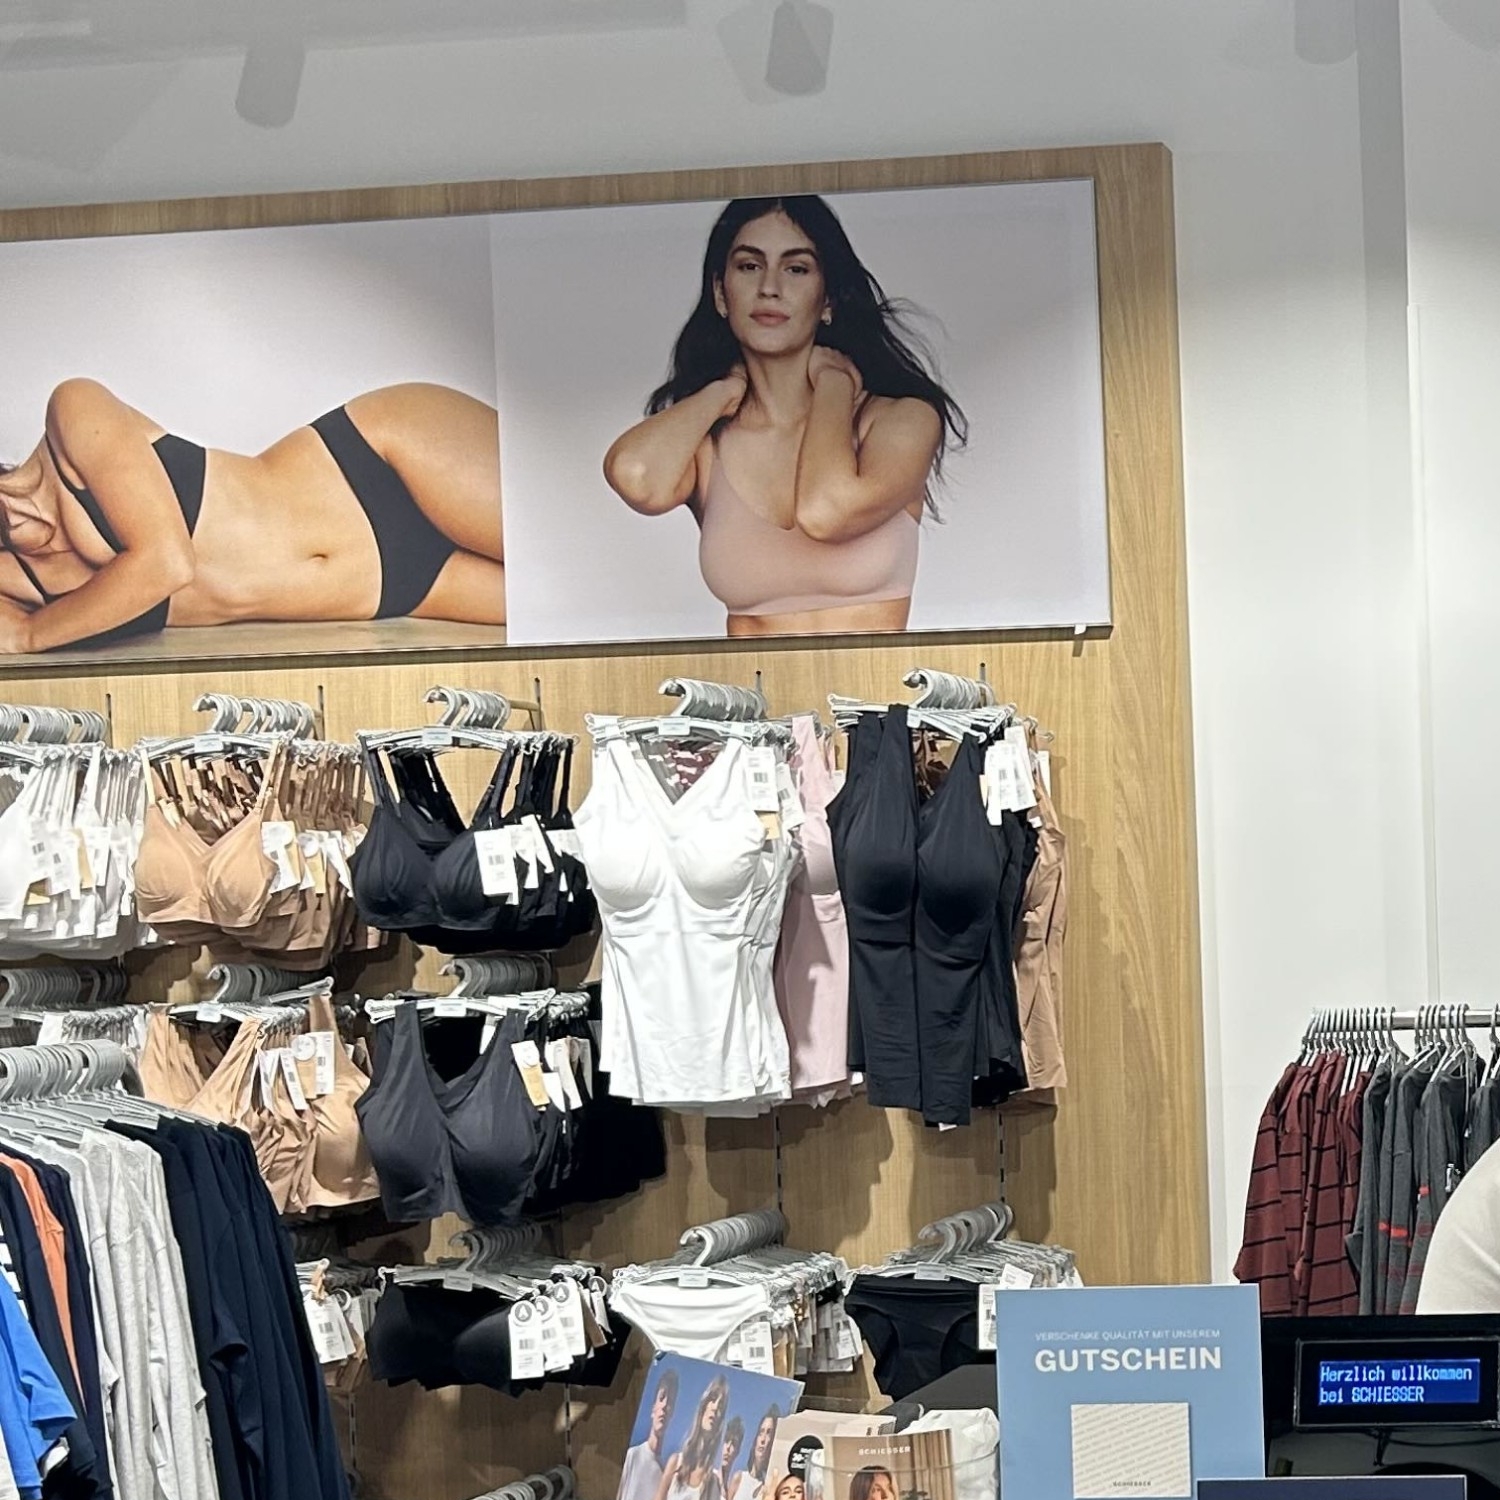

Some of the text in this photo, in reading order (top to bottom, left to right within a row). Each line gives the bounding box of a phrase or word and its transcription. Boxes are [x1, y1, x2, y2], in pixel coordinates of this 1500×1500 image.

[1035, 1329, 1221, 1341] VERSCHENKE QUALITÄT MIT UNSEREM
[1035, 1346, 1221, 1372] GUTSCHEIN
[1320, 1364, 1473, 1382] Herzlich willkommen
[1320, 1386, 1425, 1403] bei SCHIESSER
[858, 1446, 911, 1455] SCHIESSER
